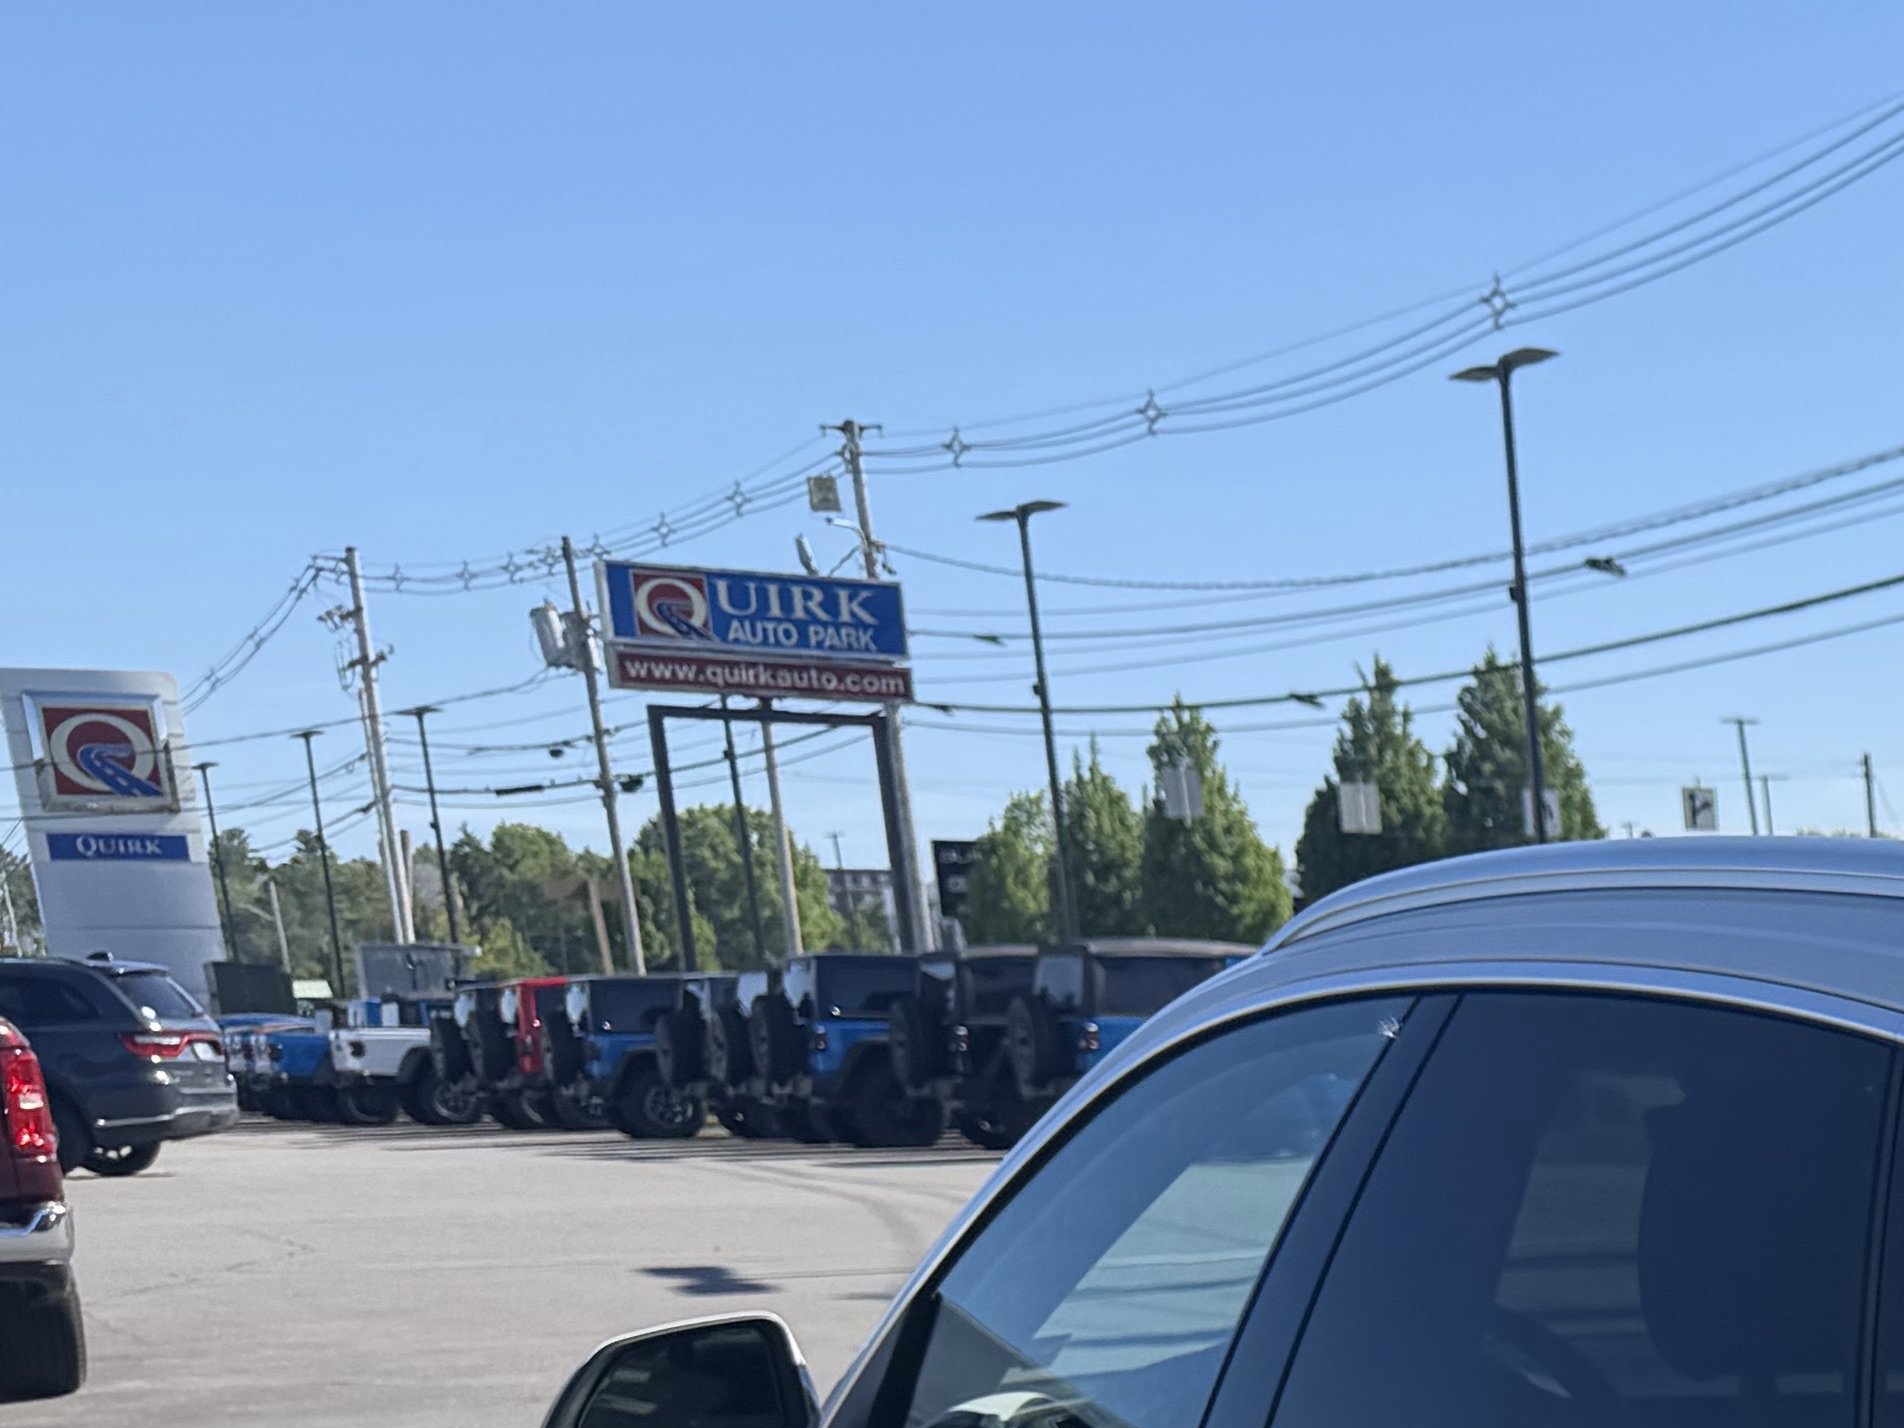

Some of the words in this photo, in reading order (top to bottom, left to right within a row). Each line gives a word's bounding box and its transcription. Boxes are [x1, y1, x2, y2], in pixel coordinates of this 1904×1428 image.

[635, 577, 880, 638] QUIRK
[728, 618, 798, 647] AUTO
[808, 624, 879, 653] PARK
[625, 658, 906, 695] www.quirkauto.com
